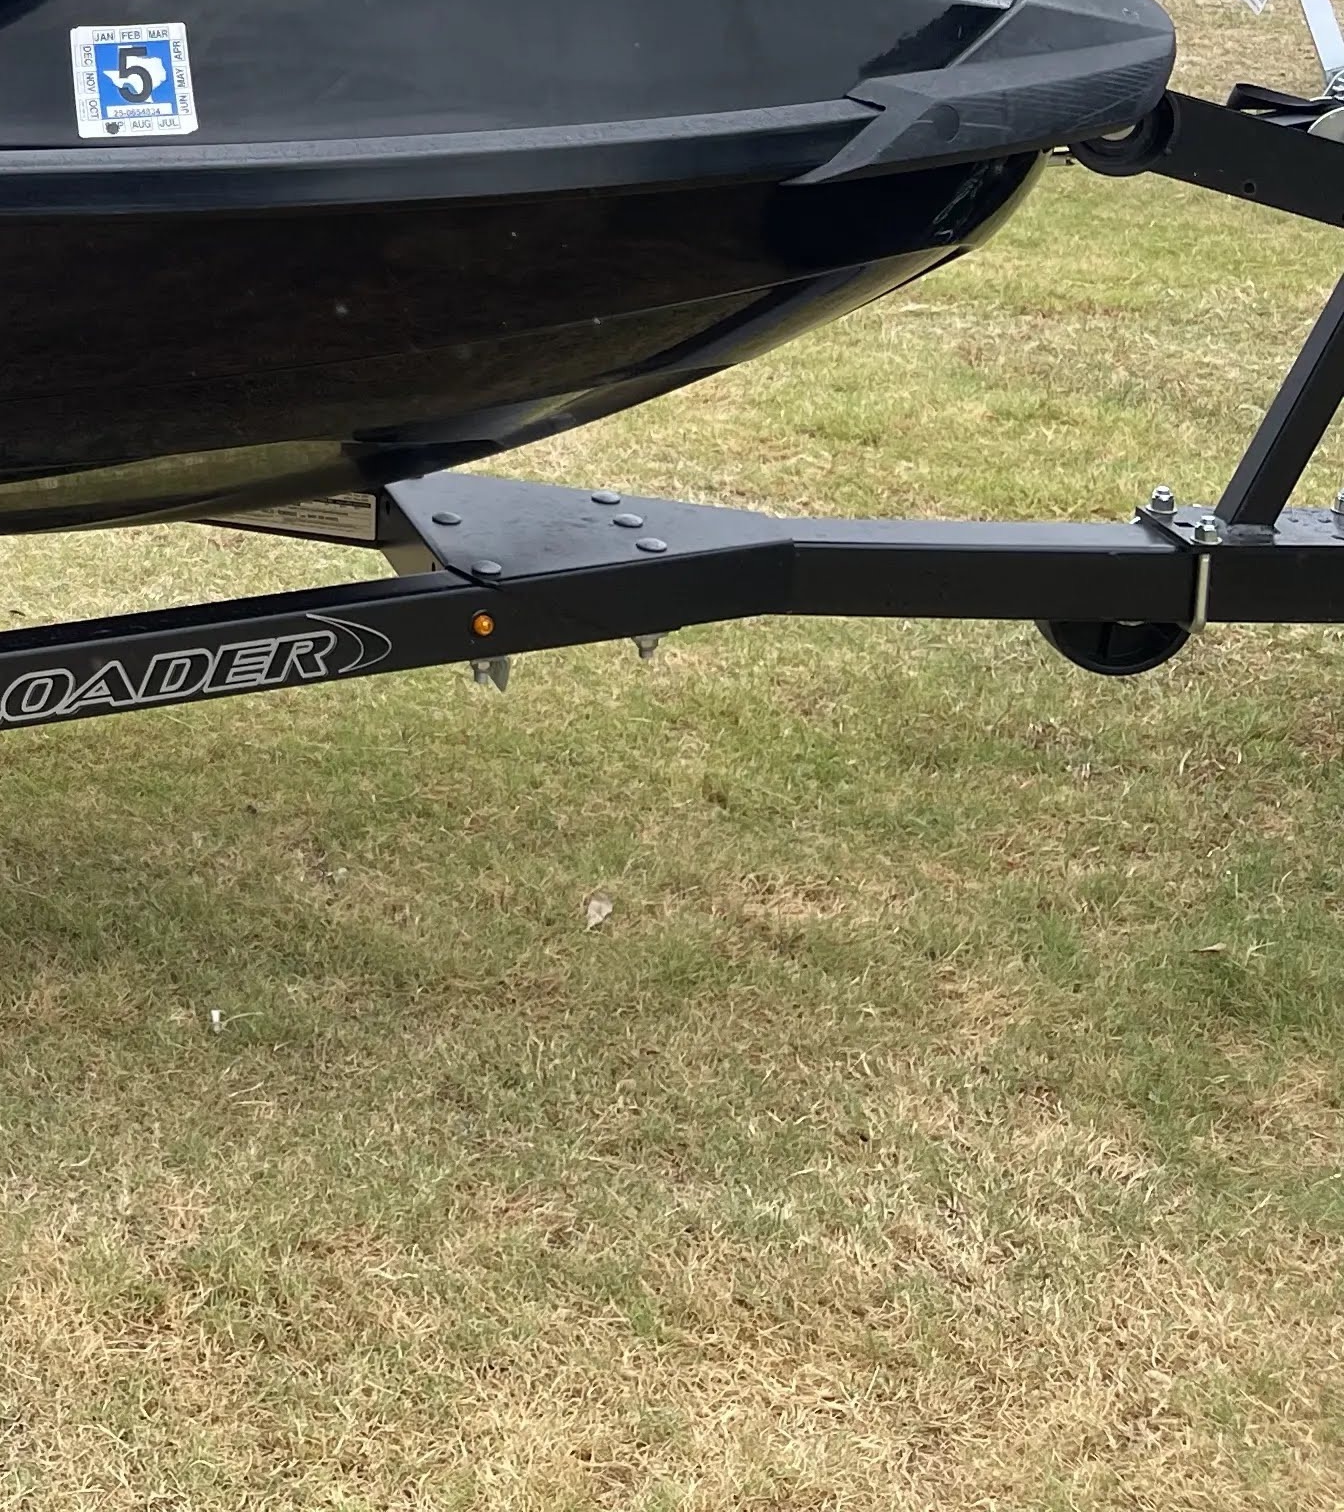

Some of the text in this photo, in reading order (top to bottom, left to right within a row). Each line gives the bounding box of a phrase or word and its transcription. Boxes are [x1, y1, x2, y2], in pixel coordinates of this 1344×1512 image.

[94, 28, 168, 42] JAN FEB MAR
[172, 40, 183, 61] APR
[118, 46, 154, 103] 5
[175, 67, 187, 88] MAY
[132, 119, 152, 129] AUG
[159, 116, 179, 128] JUL
